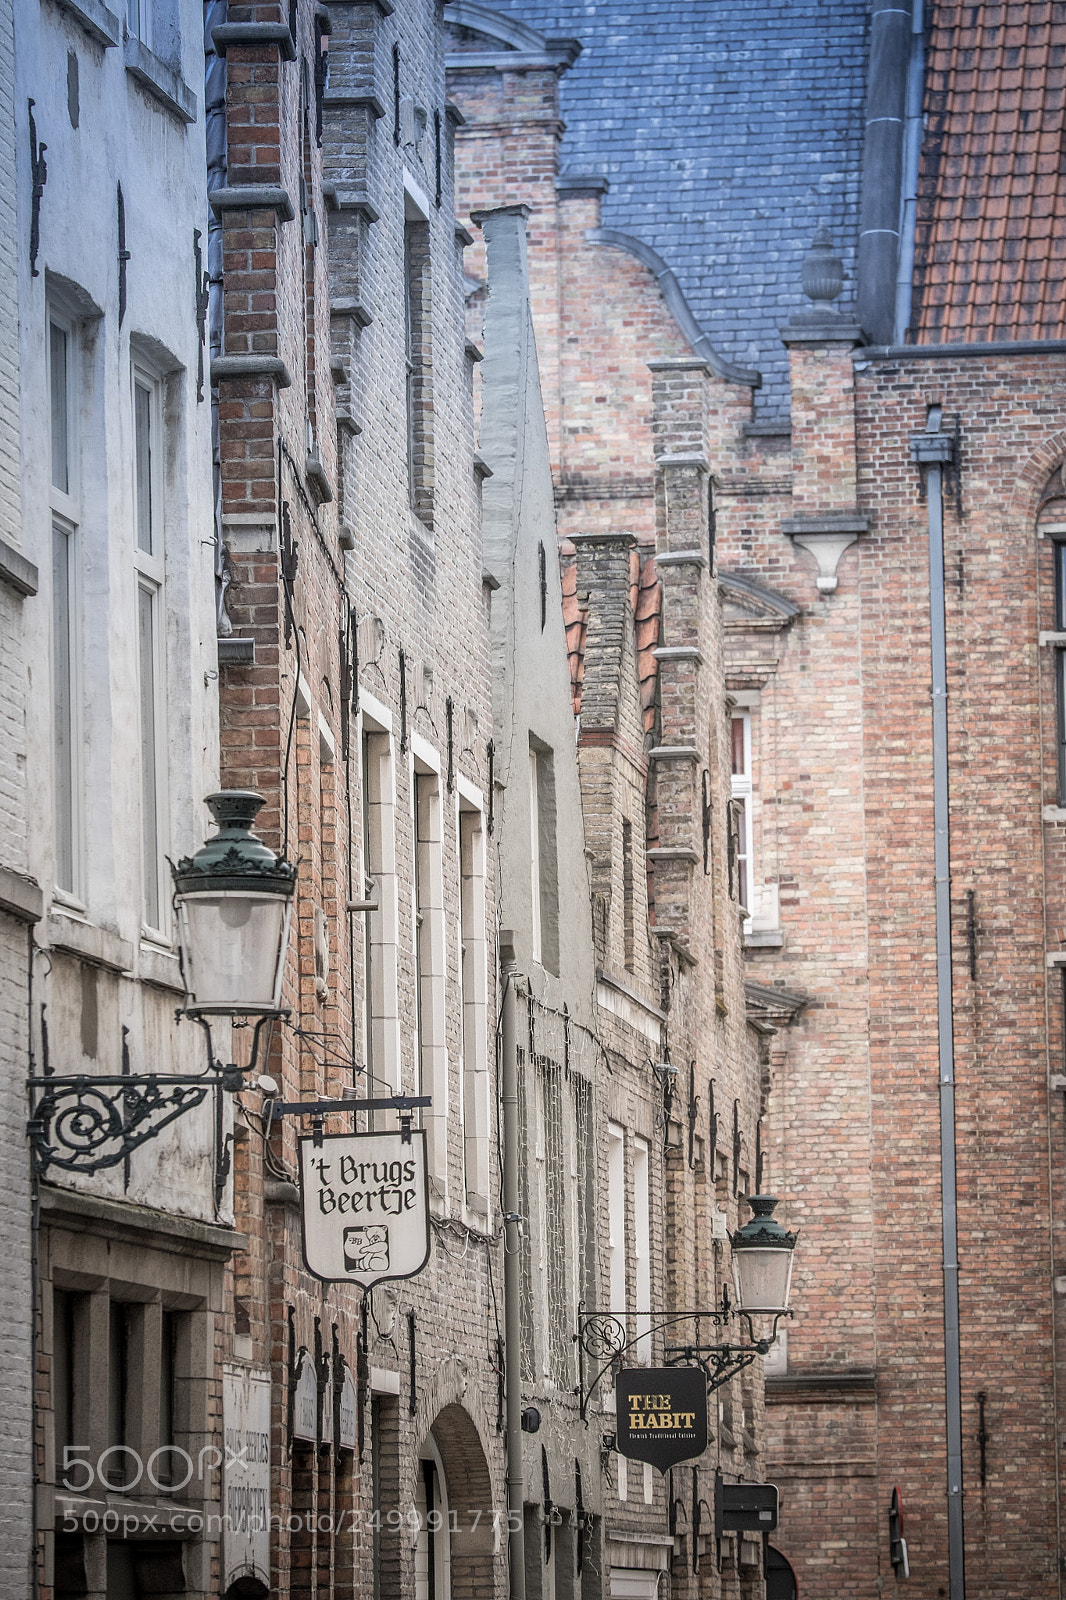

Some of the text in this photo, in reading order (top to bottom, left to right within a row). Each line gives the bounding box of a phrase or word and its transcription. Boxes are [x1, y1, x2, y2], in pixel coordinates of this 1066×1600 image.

[310, 1155, 417, 1187] 't Brugs
[317, 1185, 417, 1215] Beertje
[628, 1394, 671, 1411] THE
[628, 1412, 696, 1429] HABIT
